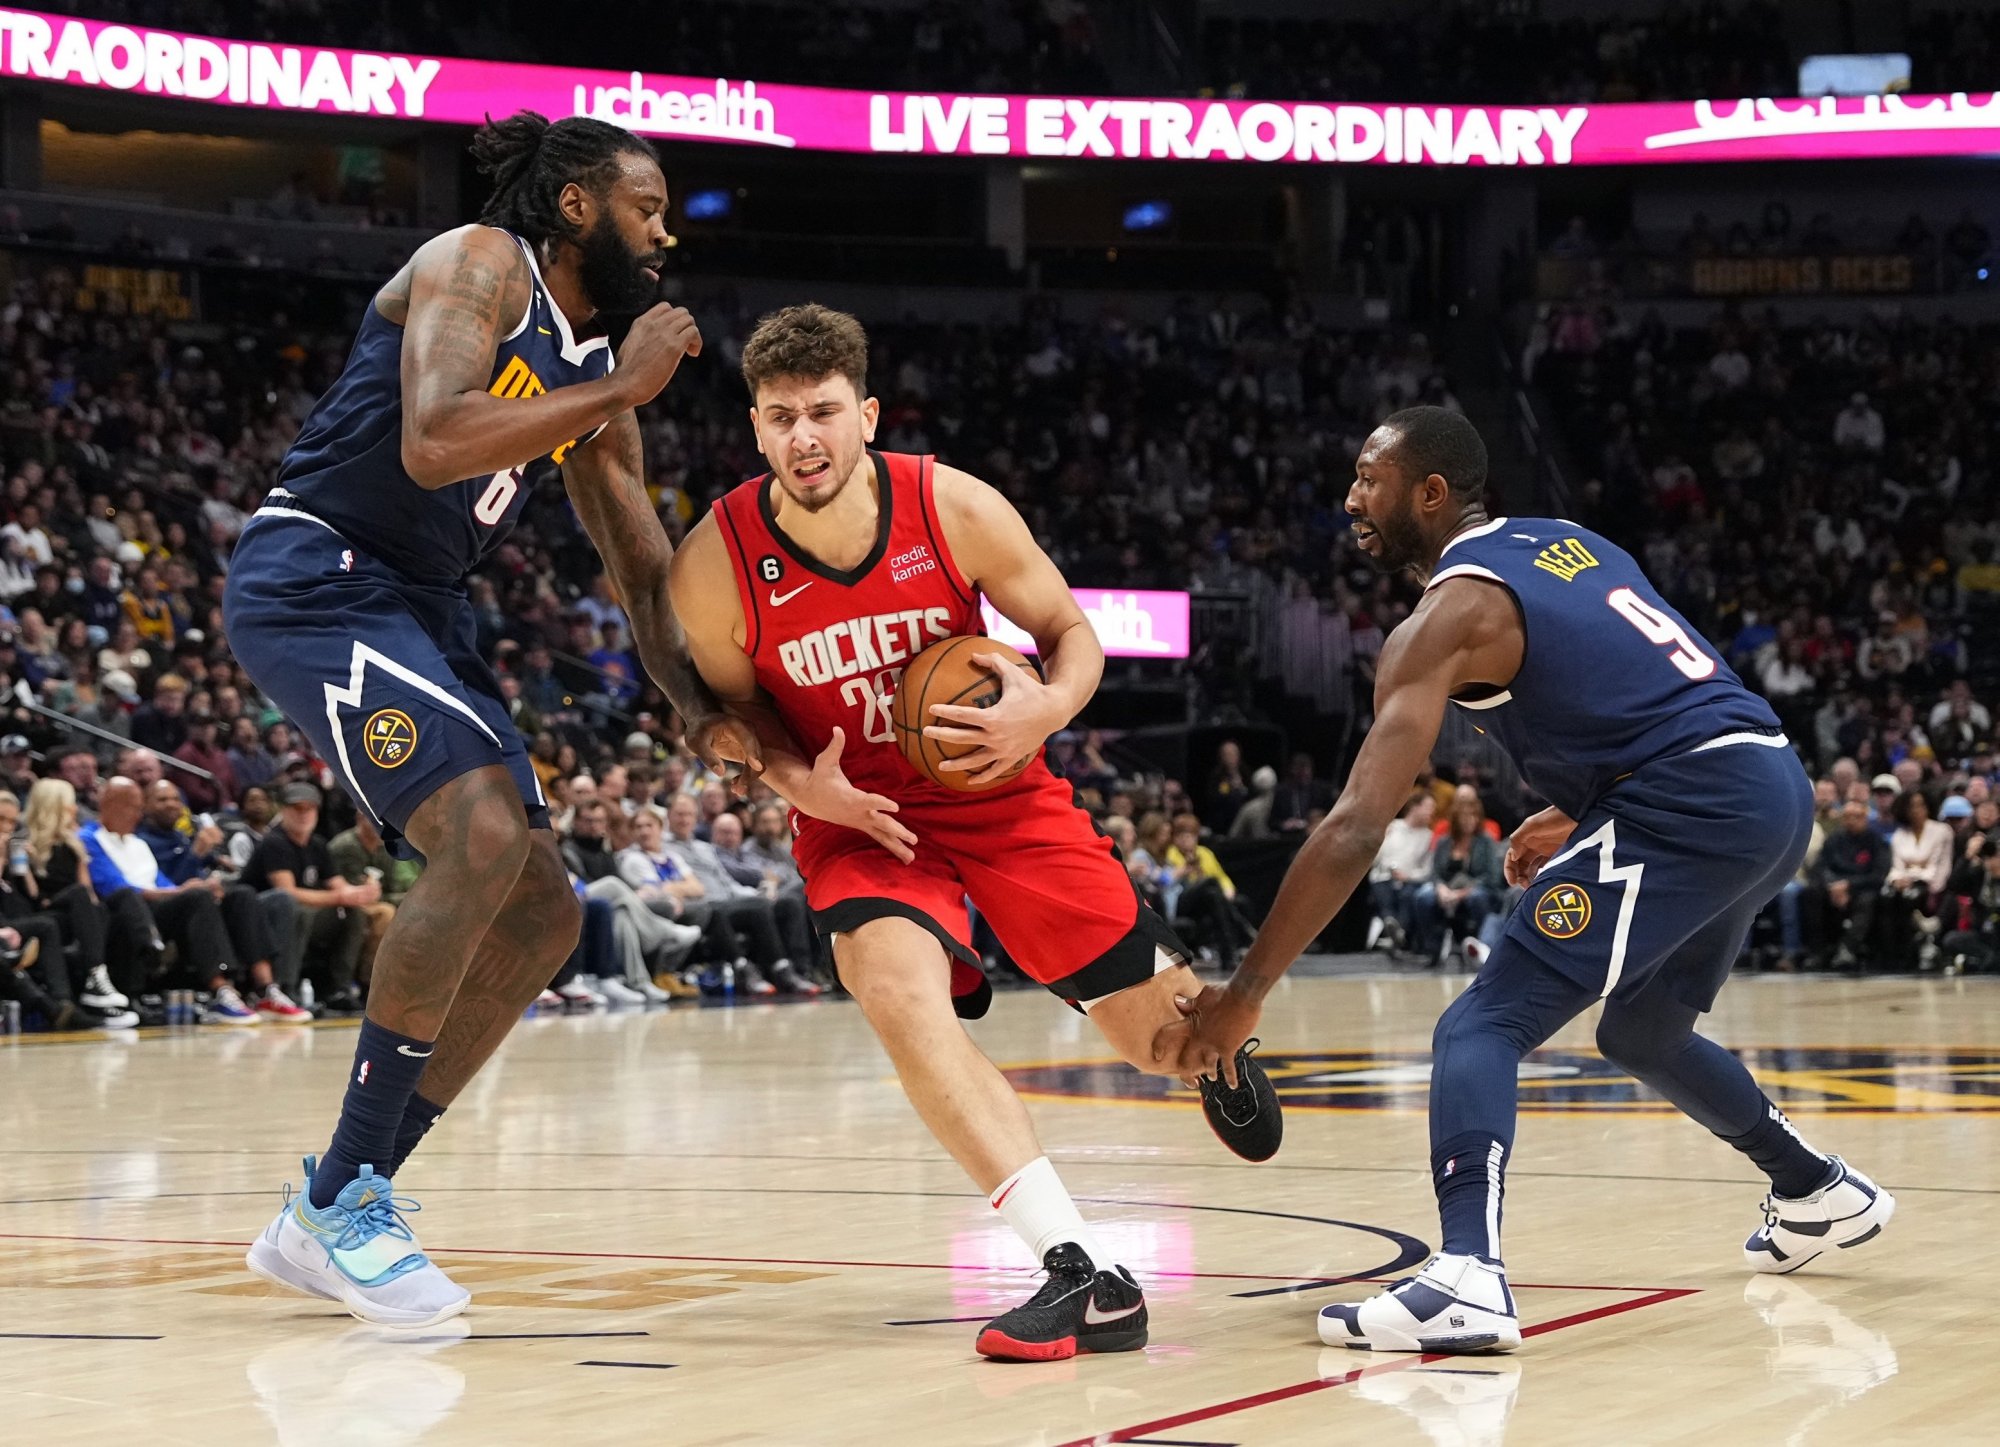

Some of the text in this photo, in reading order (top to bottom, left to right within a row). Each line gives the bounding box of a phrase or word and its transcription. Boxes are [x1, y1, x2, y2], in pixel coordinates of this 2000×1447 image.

[573, 71, 775, 138] uchealth
[870, 94, 1588, 166] LIVE EXTRAORDINARY
[763, 558, 780, 580] 6
[890, 545, 929, 569] credit
[891, 558, 936, 584] karma
[1533, 538, 1600, 583] REED
[777, 606, 952, 687] ROCKETS
[1606, 586, 1716, 681] 9
